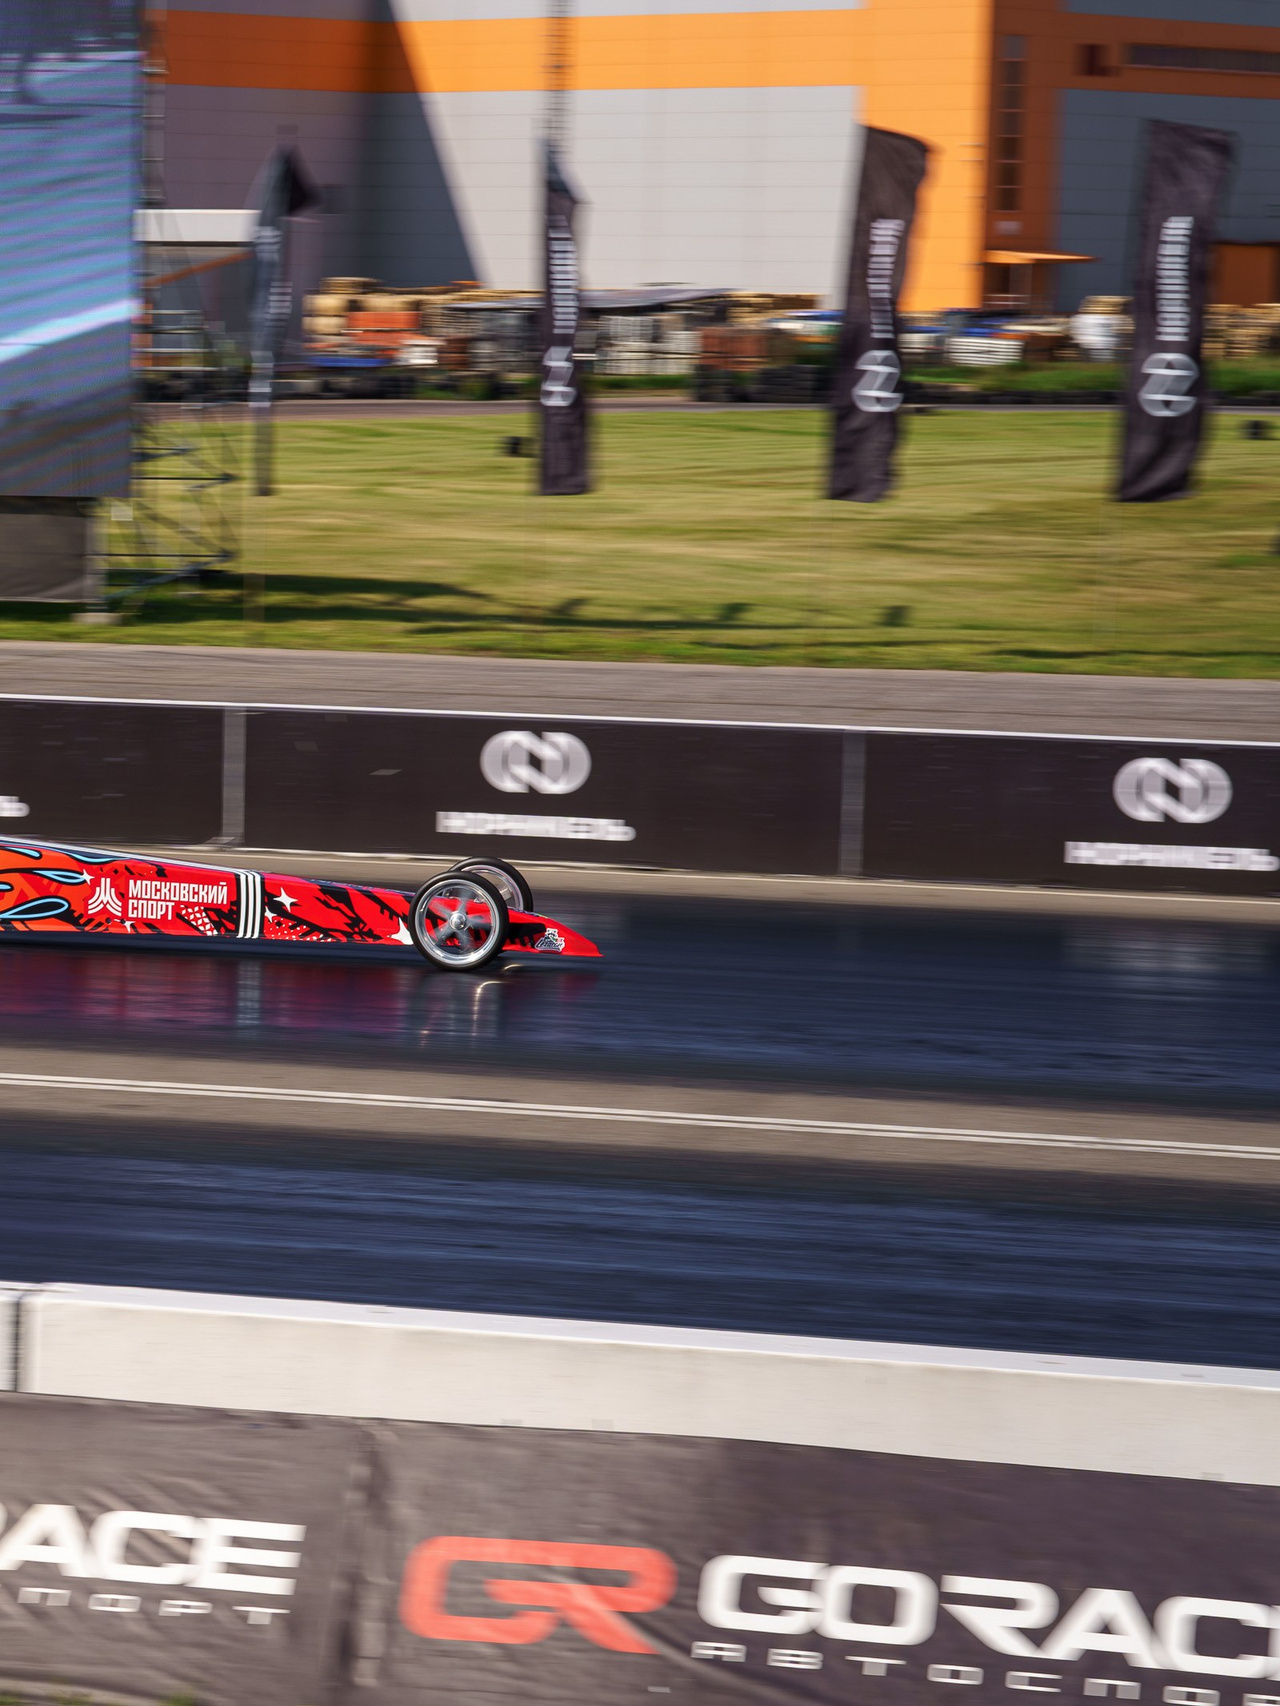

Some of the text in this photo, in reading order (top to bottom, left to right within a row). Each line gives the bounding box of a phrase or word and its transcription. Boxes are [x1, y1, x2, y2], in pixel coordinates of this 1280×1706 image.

[128, 879, 228, 904] МОСКОВСКИЙ
[128, 899, 175, 920] СПОРТ
[697, 1554, 1280, 1680] GORAC
